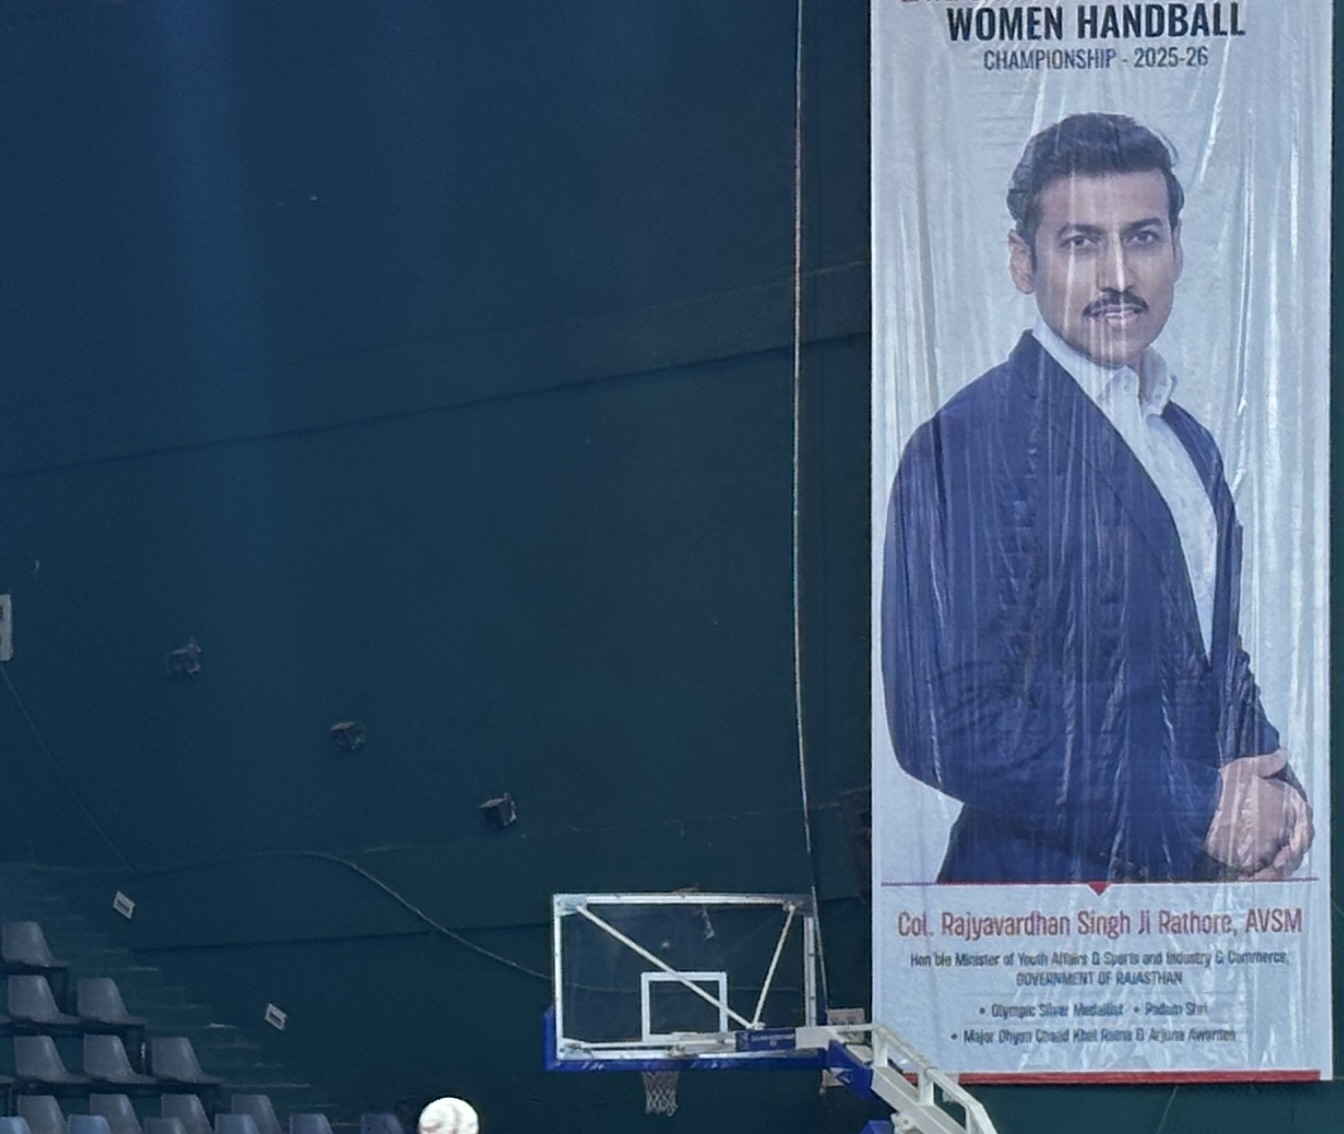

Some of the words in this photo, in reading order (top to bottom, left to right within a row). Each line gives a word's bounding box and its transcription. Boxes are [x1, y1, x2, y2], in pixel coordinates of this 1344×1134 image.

[947, 6, 1063, 41] WOMEN
[1077, 2, 1246, 40] HANDBALL
[983, 48, 1117, 71] CHAMPIONSHIP
[1133, 46, 1209, 68] 2025-26
[897, 911, 934, 937] Col.
[942, 910, 1071, 941] Rajyavardhan
[1077, 910, 1131, 940] Singh
[1138, 910, 1151, 935] Ji
[1159, 909, 1238, 937] Rathore,
[1245, 908, 1303, 933] AVSM
[956, 952, 1000, 967] Minister
[1003, 952, 1015, 966] of
[1018, 952, 1049, 966] Youth
[1051, 951, 1087, 966] Affairs
[1103, 952, 1140, 967] Sports
[1142, 952, 1163, 965] and
[1166, 952, 1211, 967] Industry
[1215, 952, 1224, 964] &
[1227, 951, 1290, 966] Commerce,
[1016, 971, 1095, 986] GOVERNMENT
[1098, 971, 1113, 985] OF
[1116, 971, 1183, 985] RAJASTHAN
[991, 1003, 1036, 1019] Olympic
[1039, 1003, 1068, 1017] Silver
[963, 1030, 995, 1045] Major
[998, 1029, 1032, 1046] Dhyan
